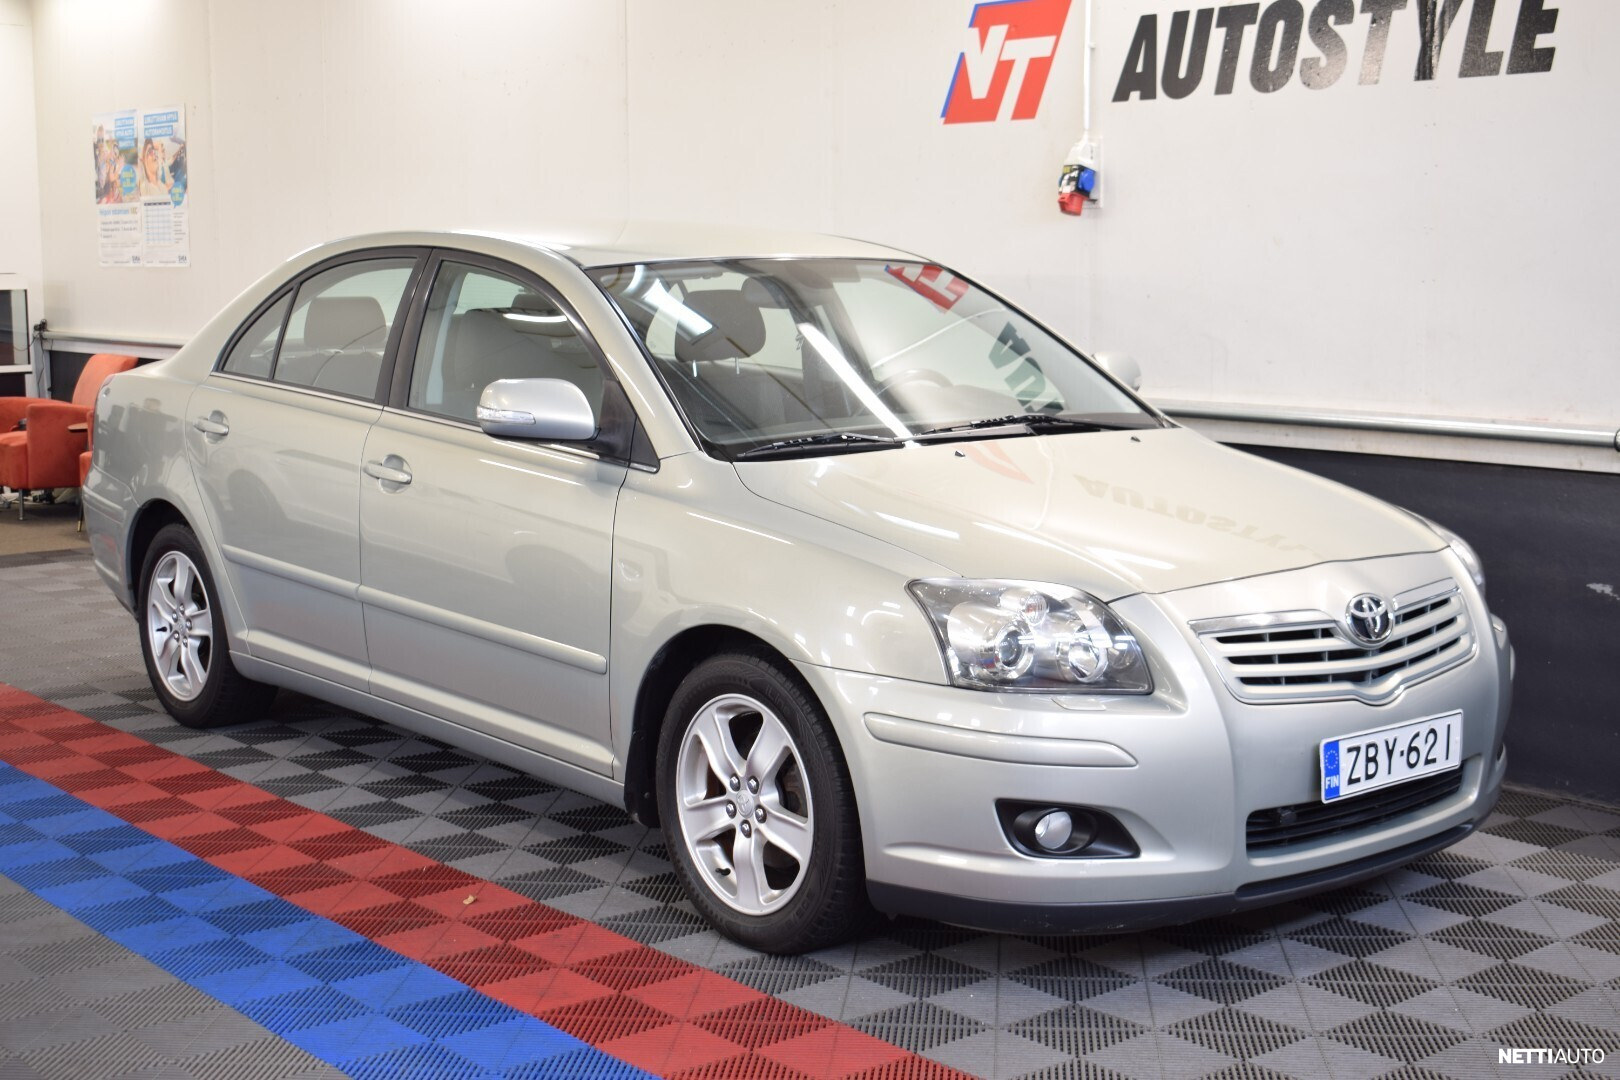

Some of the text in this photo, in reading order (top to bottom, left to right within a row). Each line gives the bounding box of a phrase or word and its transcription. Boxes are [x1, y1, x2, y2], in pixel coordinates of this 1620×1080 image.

[1112, 0, 1560, 102] AUTOSTYLE
[1325, 774, 1340, 790] FIN
[1346, 723, 1451, 786] ZBY-621
